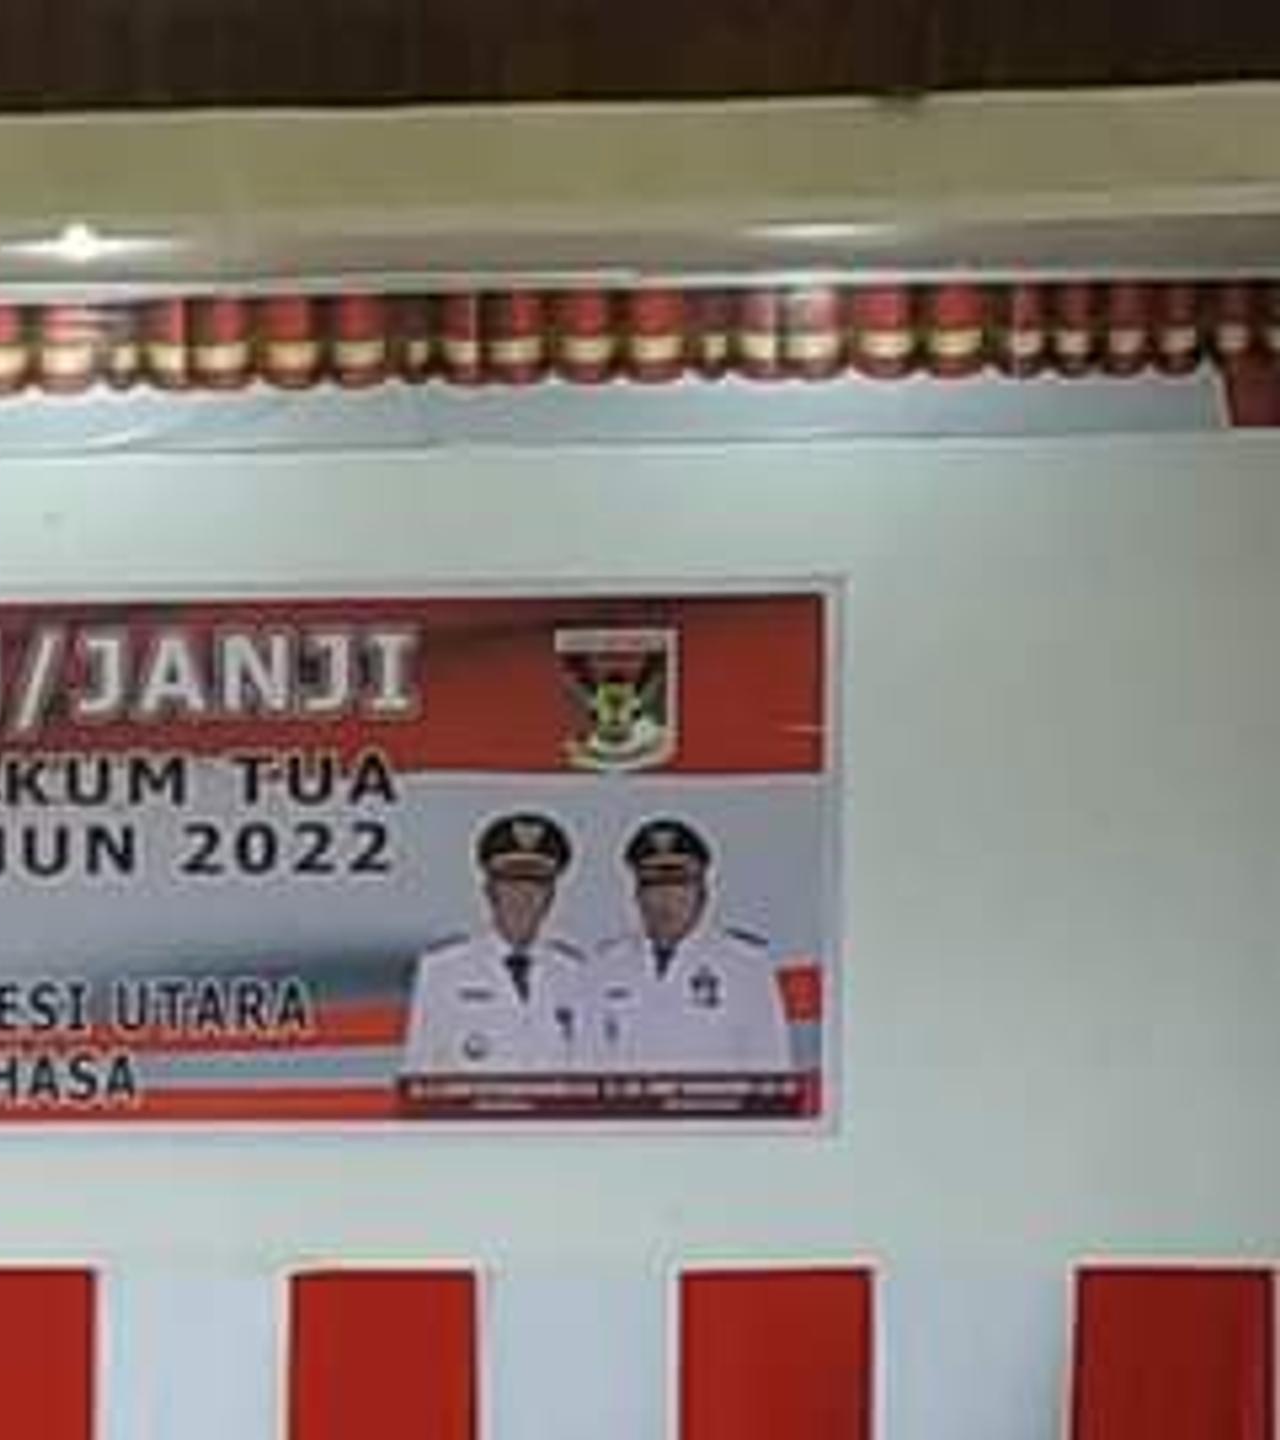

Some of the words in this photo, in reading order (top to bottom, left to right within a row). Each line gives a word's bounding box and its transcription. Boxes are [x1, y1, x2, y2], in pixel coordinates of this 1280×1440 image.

[238, 751, 400, 807] TUA
[178, 819, 394, 877] 2022
[114, 979, 310, 1033] UTARA
